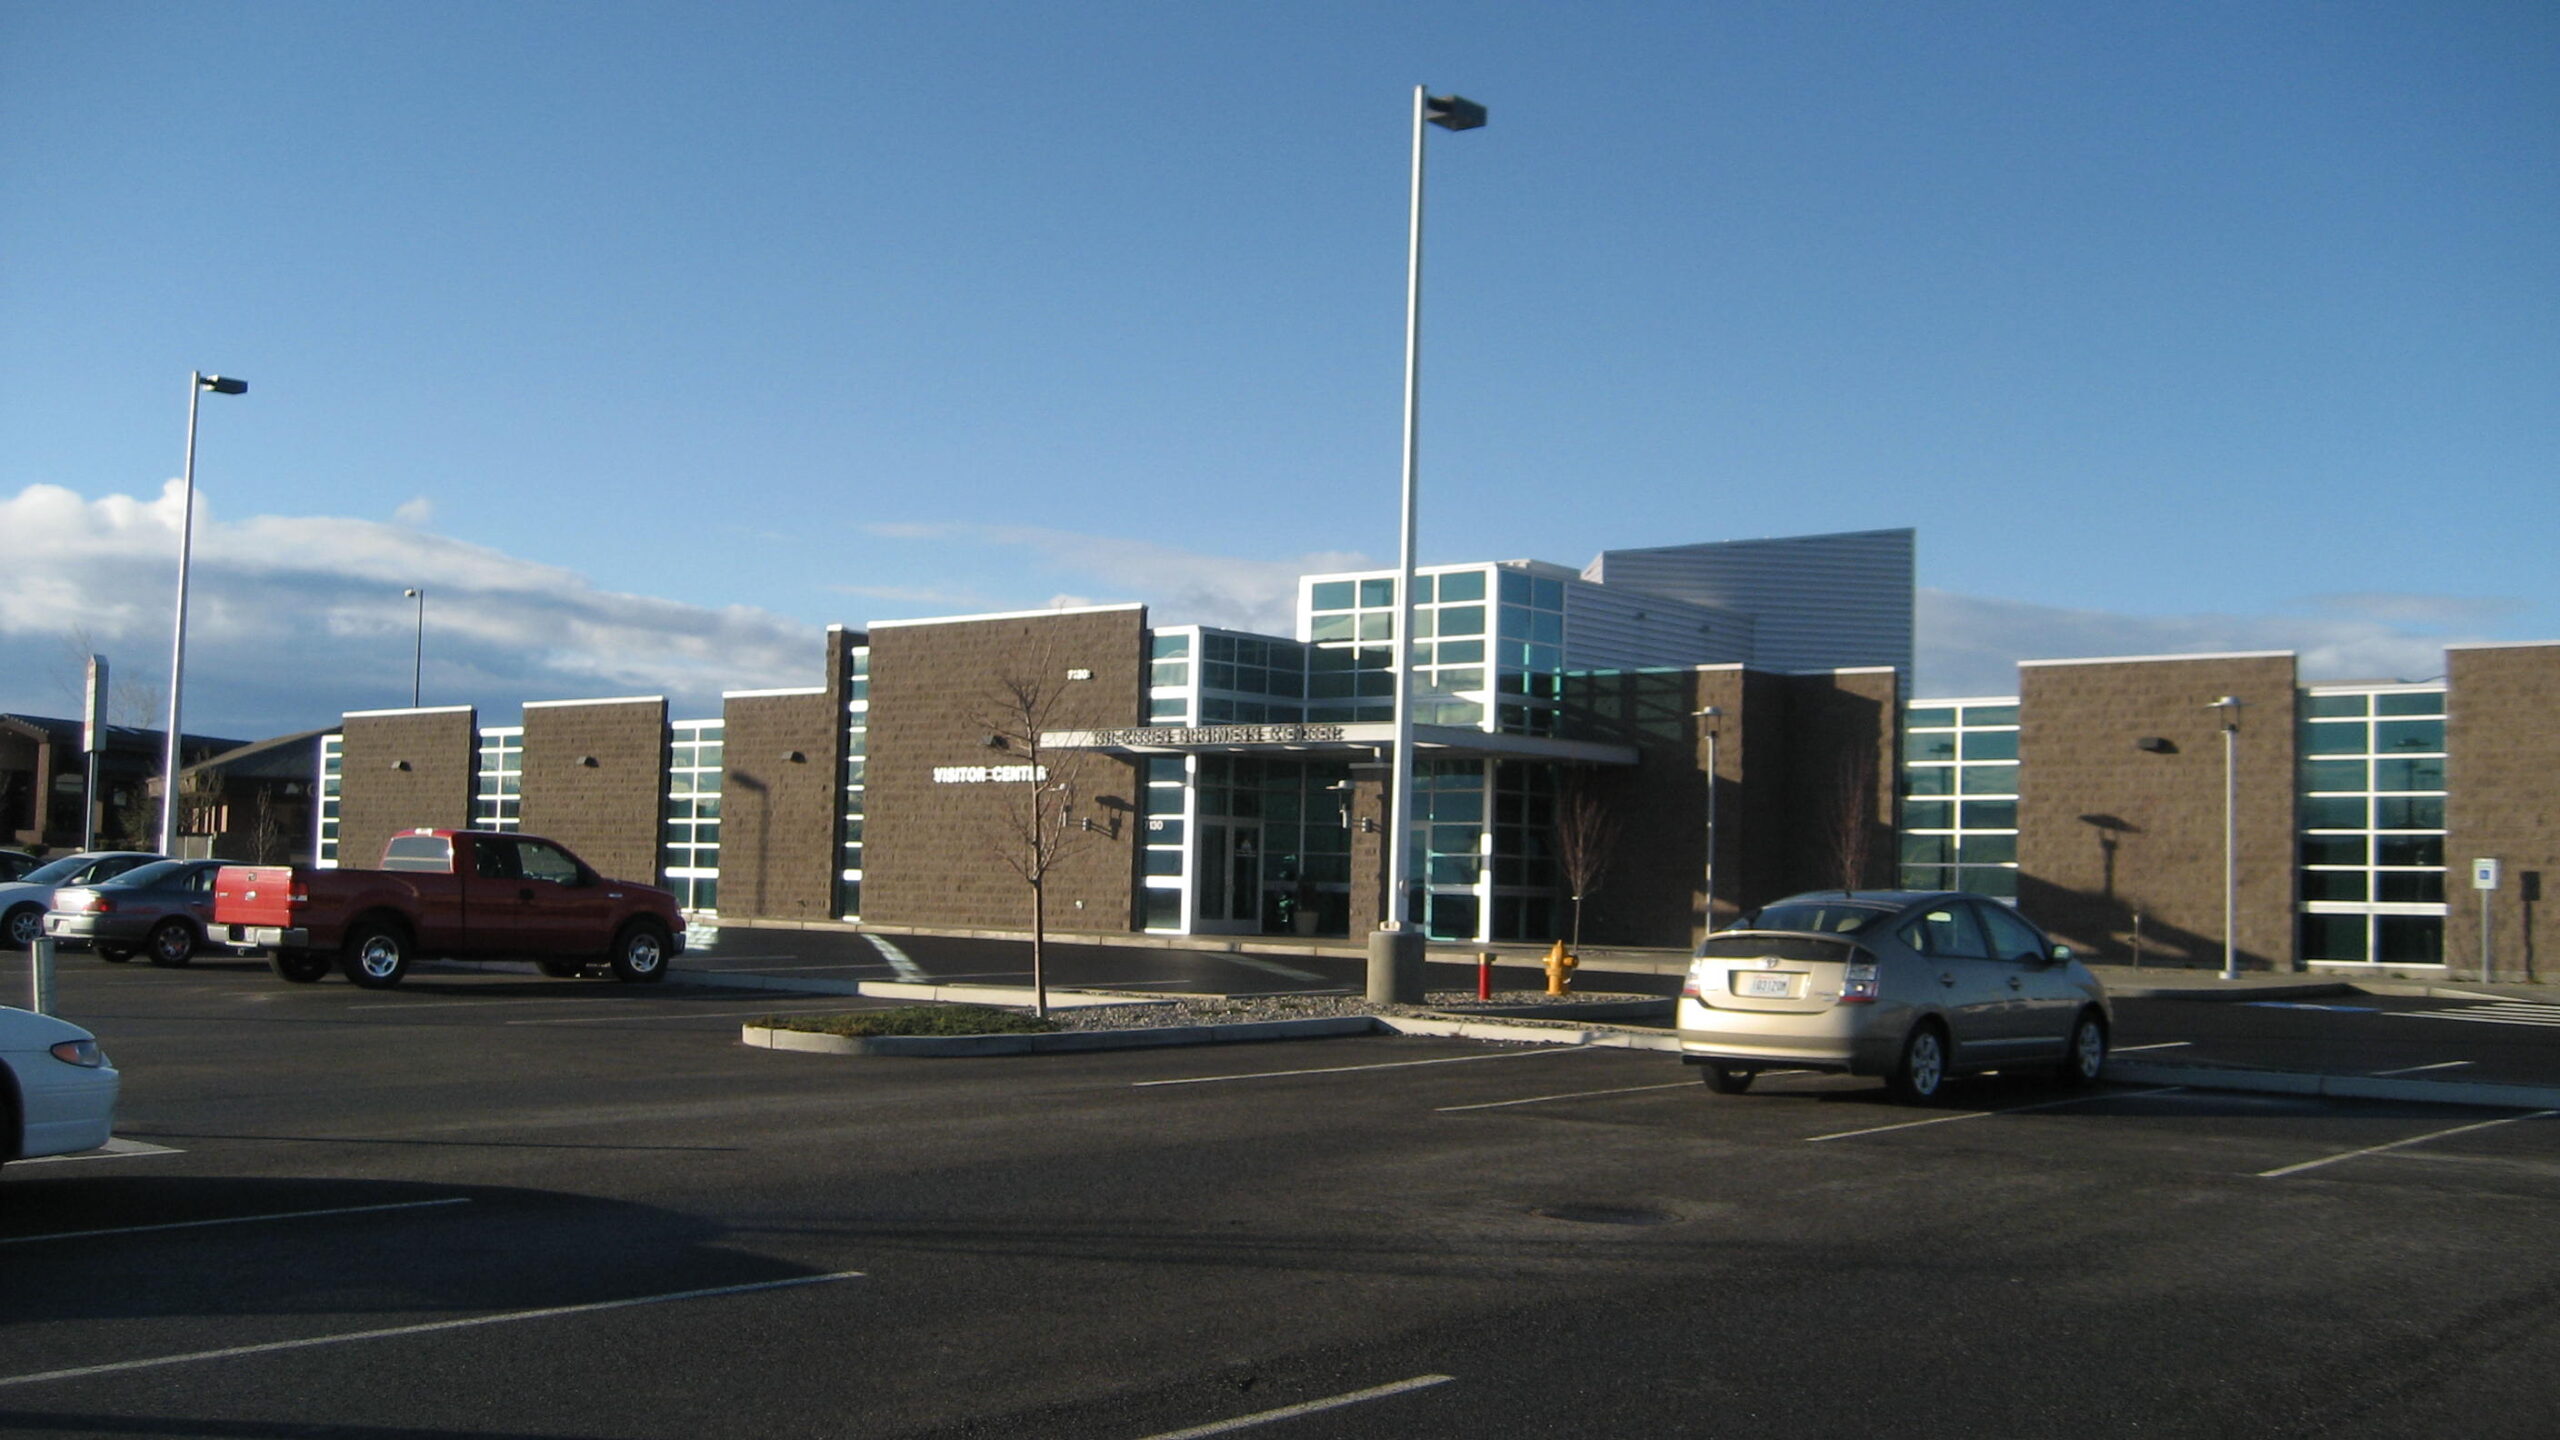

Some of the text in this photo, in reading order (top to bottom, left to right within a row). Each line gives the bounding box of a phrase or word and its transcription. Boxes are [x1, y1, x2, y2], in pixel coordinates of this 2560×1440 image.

[1180, 726, 1263, 744] BUSINESS
[1271, 724, 1344, 742] CENTER
[933, 766, 986, 783] VISITOR
